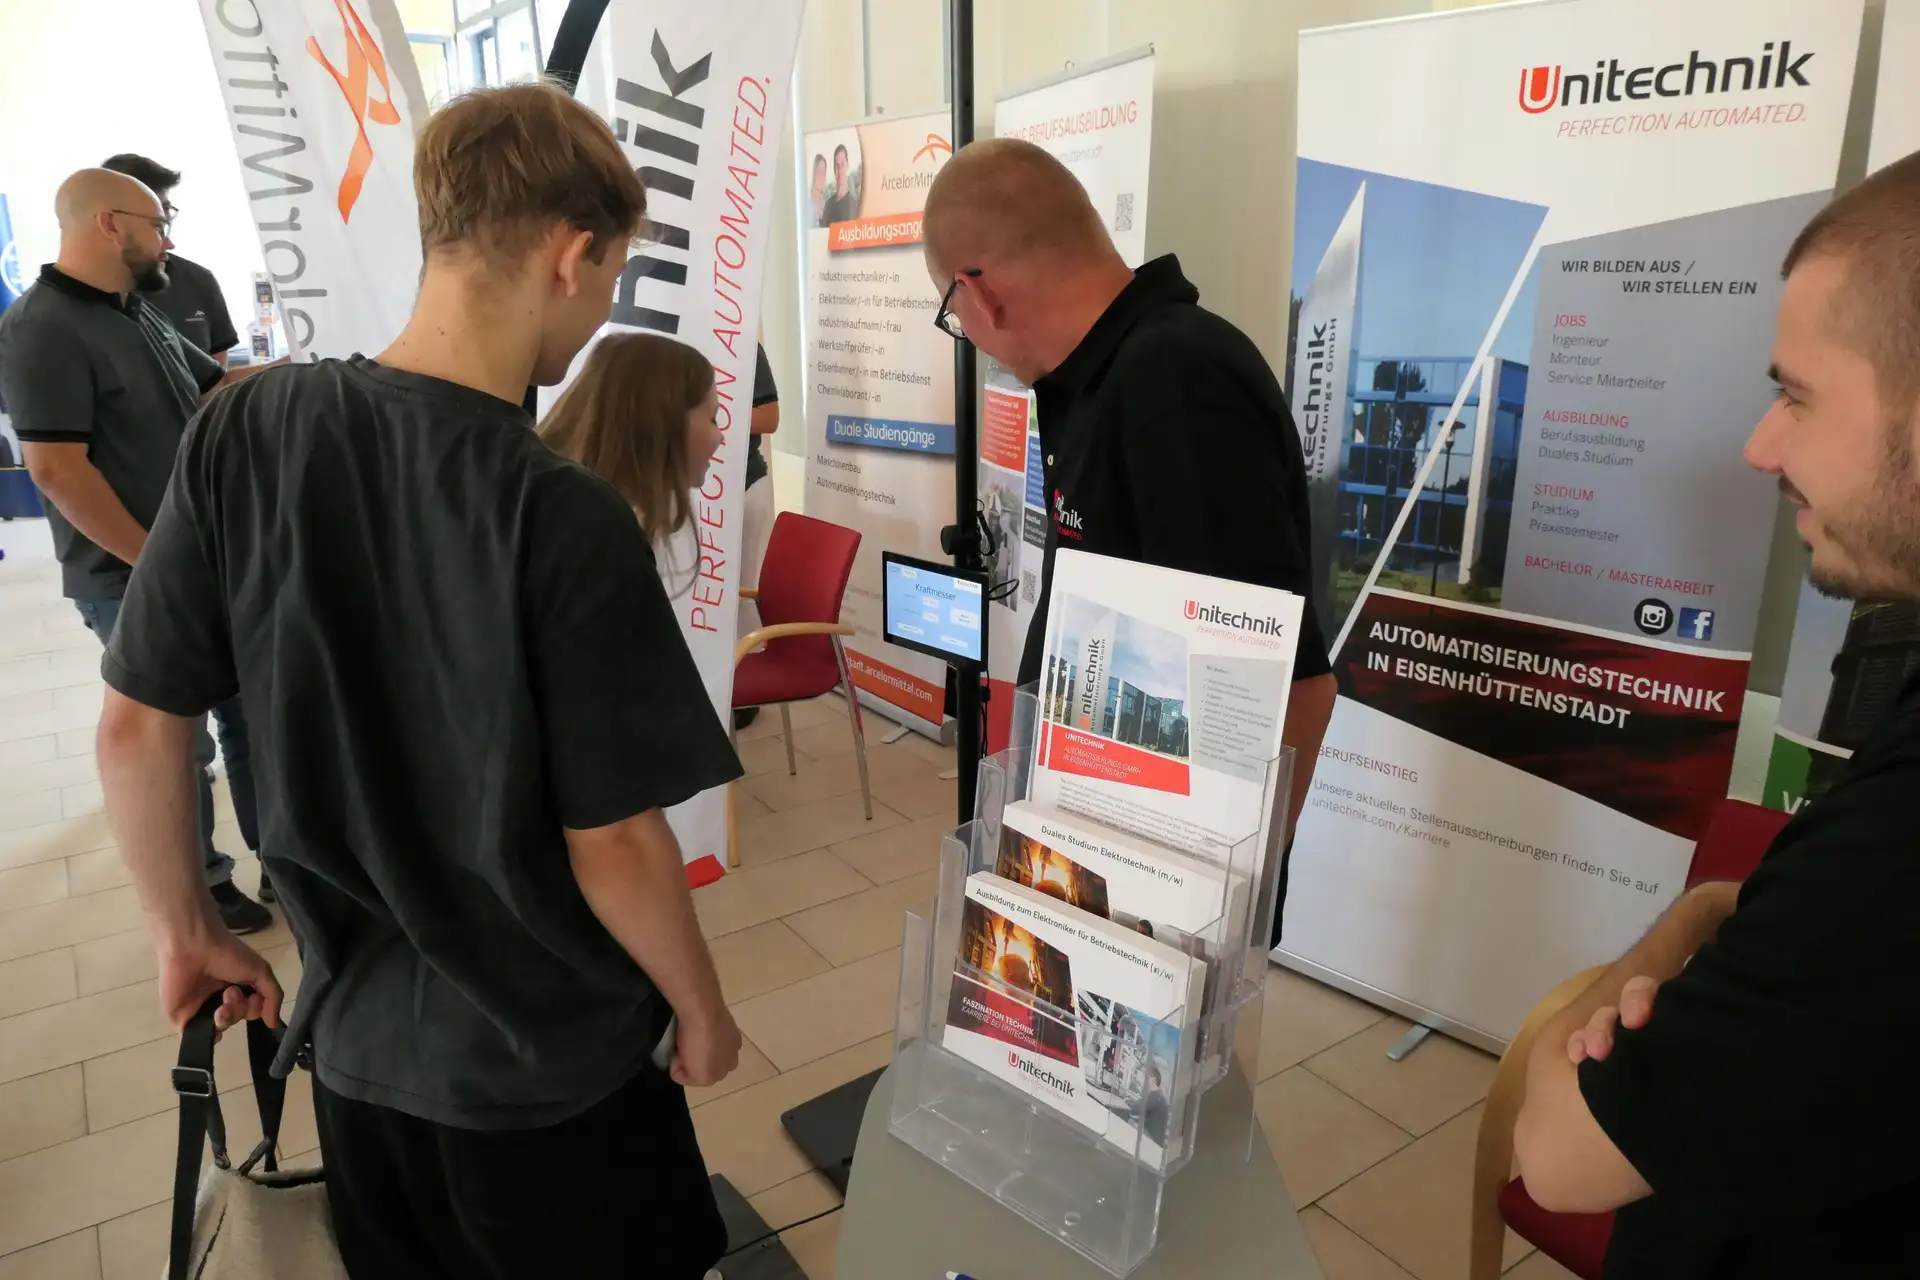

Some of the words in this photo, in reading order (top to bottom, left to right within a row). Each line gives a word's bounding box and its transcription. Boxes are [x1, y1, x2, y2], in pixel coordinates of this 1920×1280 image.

[1519, 41, 1815, 114] Unitechnik
[1557, 112, 1672, 138] PERFECTION
[1675, 103, 1806, 130] AUTOMATED.
[713, 76, 771, 358] AUTOMATED.
[1561, 261, 1588, 273] WIR
[1593, 260, 1645, 273] BILDEN
[1650, 260, 1681, 273] AUS
[1622, 281, 1650, 293] WIR
[1655, 281, 1723, 294] STELLEN
[1728, 282, 1757, 294] EIN
[1554, 314, 1586, 327] JOBS
[1552, 334, 1609, 349] Ingenieur
[1550, 352, 1602, 366] Monteur
[880, 369, 931, 386] Betriebsdienst
[1548, 371, 1593, 385] Service
[1597, 374, 1667, 390] Mitarbeiter
[1542, 410, 1629, 428] AUSBILDUNG
[834, 420, 862, 437] Duale
[863, 423, 936, 448] Studiengänge
[1541, 428, 1645, 450] Berufsausbildung
[1538, 446, 1579, 462] Duales
[1583, 451, 1633, 467] Studium
[816, 476, 896, 505] Automatisierungstechnik
[1534, 483, 1594, 501] STUDIUM
[1532, 502, 1580, 518] Praktika
[1529, 519, 1619, 542] Praxissemester
[1524, 555, 1592, 577] BACHELOR
[1609, 569, 1715, 596] MASTERARBEIT
[915, 583, 956, 601] Kraftmesser
[1184, 599, 1284, 637] Unitechnik
[1369, 620, 1725, 713] AUTOMATISIERUNGSTECHNIK
[1367, 651, 1389, 673] IN
[1395, 659, 1631, 729] EISENHÜTTENSTADT
[1065, 732, 1105, 750] UNITECHNIK
[1318, 744, 1418, 783] BERUFSEINSTIEG
[1312, 797, 1450, 849] unitechnik.com/Karriere
[1314, 778, 1353, 799] Unsere
[1356, 790, 1406, 816] aktuellen
[1410, 805, 1558, 863] Stellenausschreibungen
[1562, 853, 1604, 878] finden
[1609, 868, 1631, 887] Sie
[1635, 879, 1660, 896] auf
[1041, 825, 1066, 842] Duales
[1068, 832, 1099, 852] Studium
[1100, 846, 1156, 876] Elektrotechnik
[1157, 869, 1184, 888] (m/w)
[976, 887, 1016, 912] Ausbildung
[1016, 903, 1032, 916] zum
[1033, 909, 1076, 936] Elektroniker
[1078, 928, 1089, 941] für
[1090, 934, 1149, 970] Betriebstechnik
[961, 1006, 990, 1025] KARRIERE
[991, 1018, 1001, 1029] BEI
[1001, 1023, 1037, 1047] UNITECHNIK
[963, 997, 1005, 1021] FASZINATION
[1006, 1016, 1034, 1036] TECHNIK
[1008, 1050, 1075, 1098] Unitechnik
